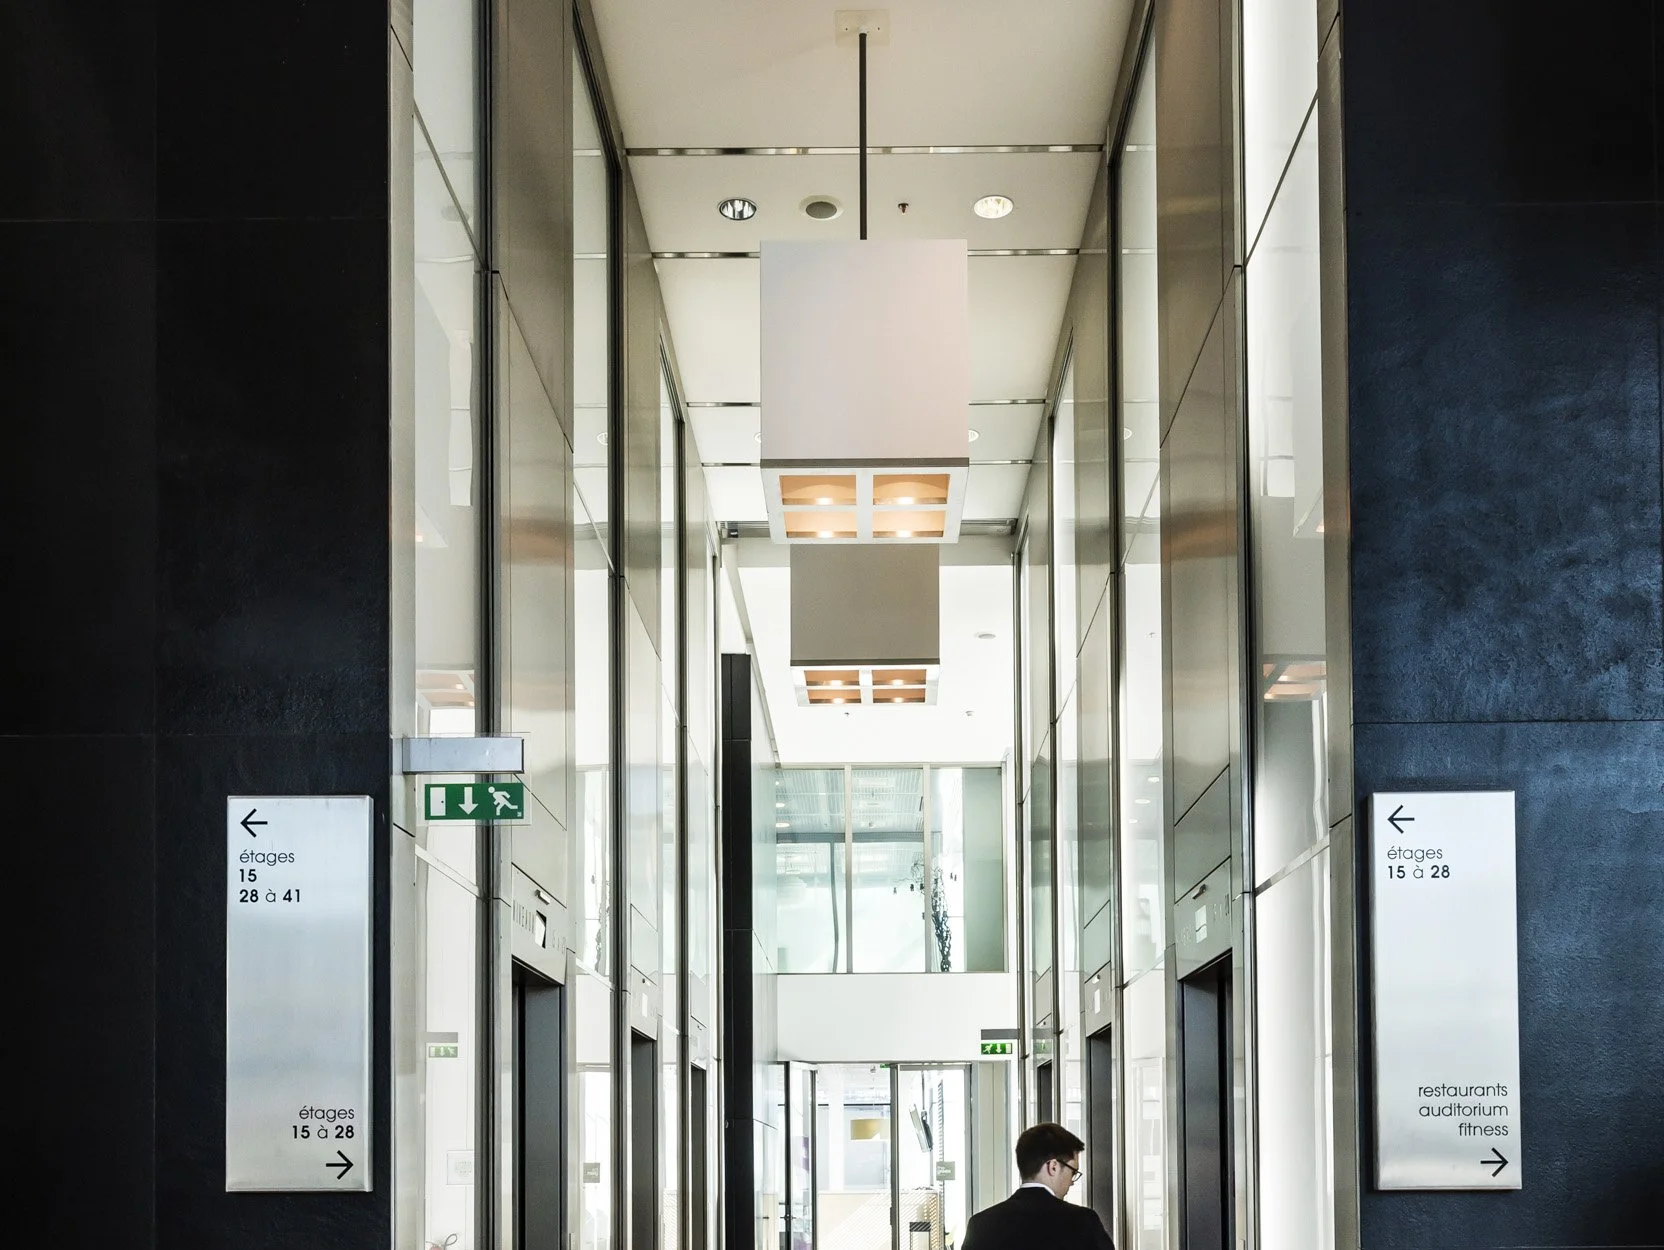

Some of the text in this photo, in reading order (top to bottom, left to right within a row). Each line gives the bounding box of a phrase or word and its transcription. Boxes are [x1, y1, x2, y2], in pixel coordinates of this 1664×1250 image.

[239, 849, 295, 866] étages
[1387, 846, 1443, 863] étages
[239, 868, 257, 883] 15
[1388, 865, 1450, 879] 15 à 28
[239, 888, 301, 903] 28 à 41
[1418, 1083, 1508, 1097] restaurants
[299, 1105, 355, 1122] étages
[1418, 1103, 1509, 1117] auditorium
[292, 1124, 355, 1139] 15 à 28
[1458, 1123, 1509, 1136] fitness
